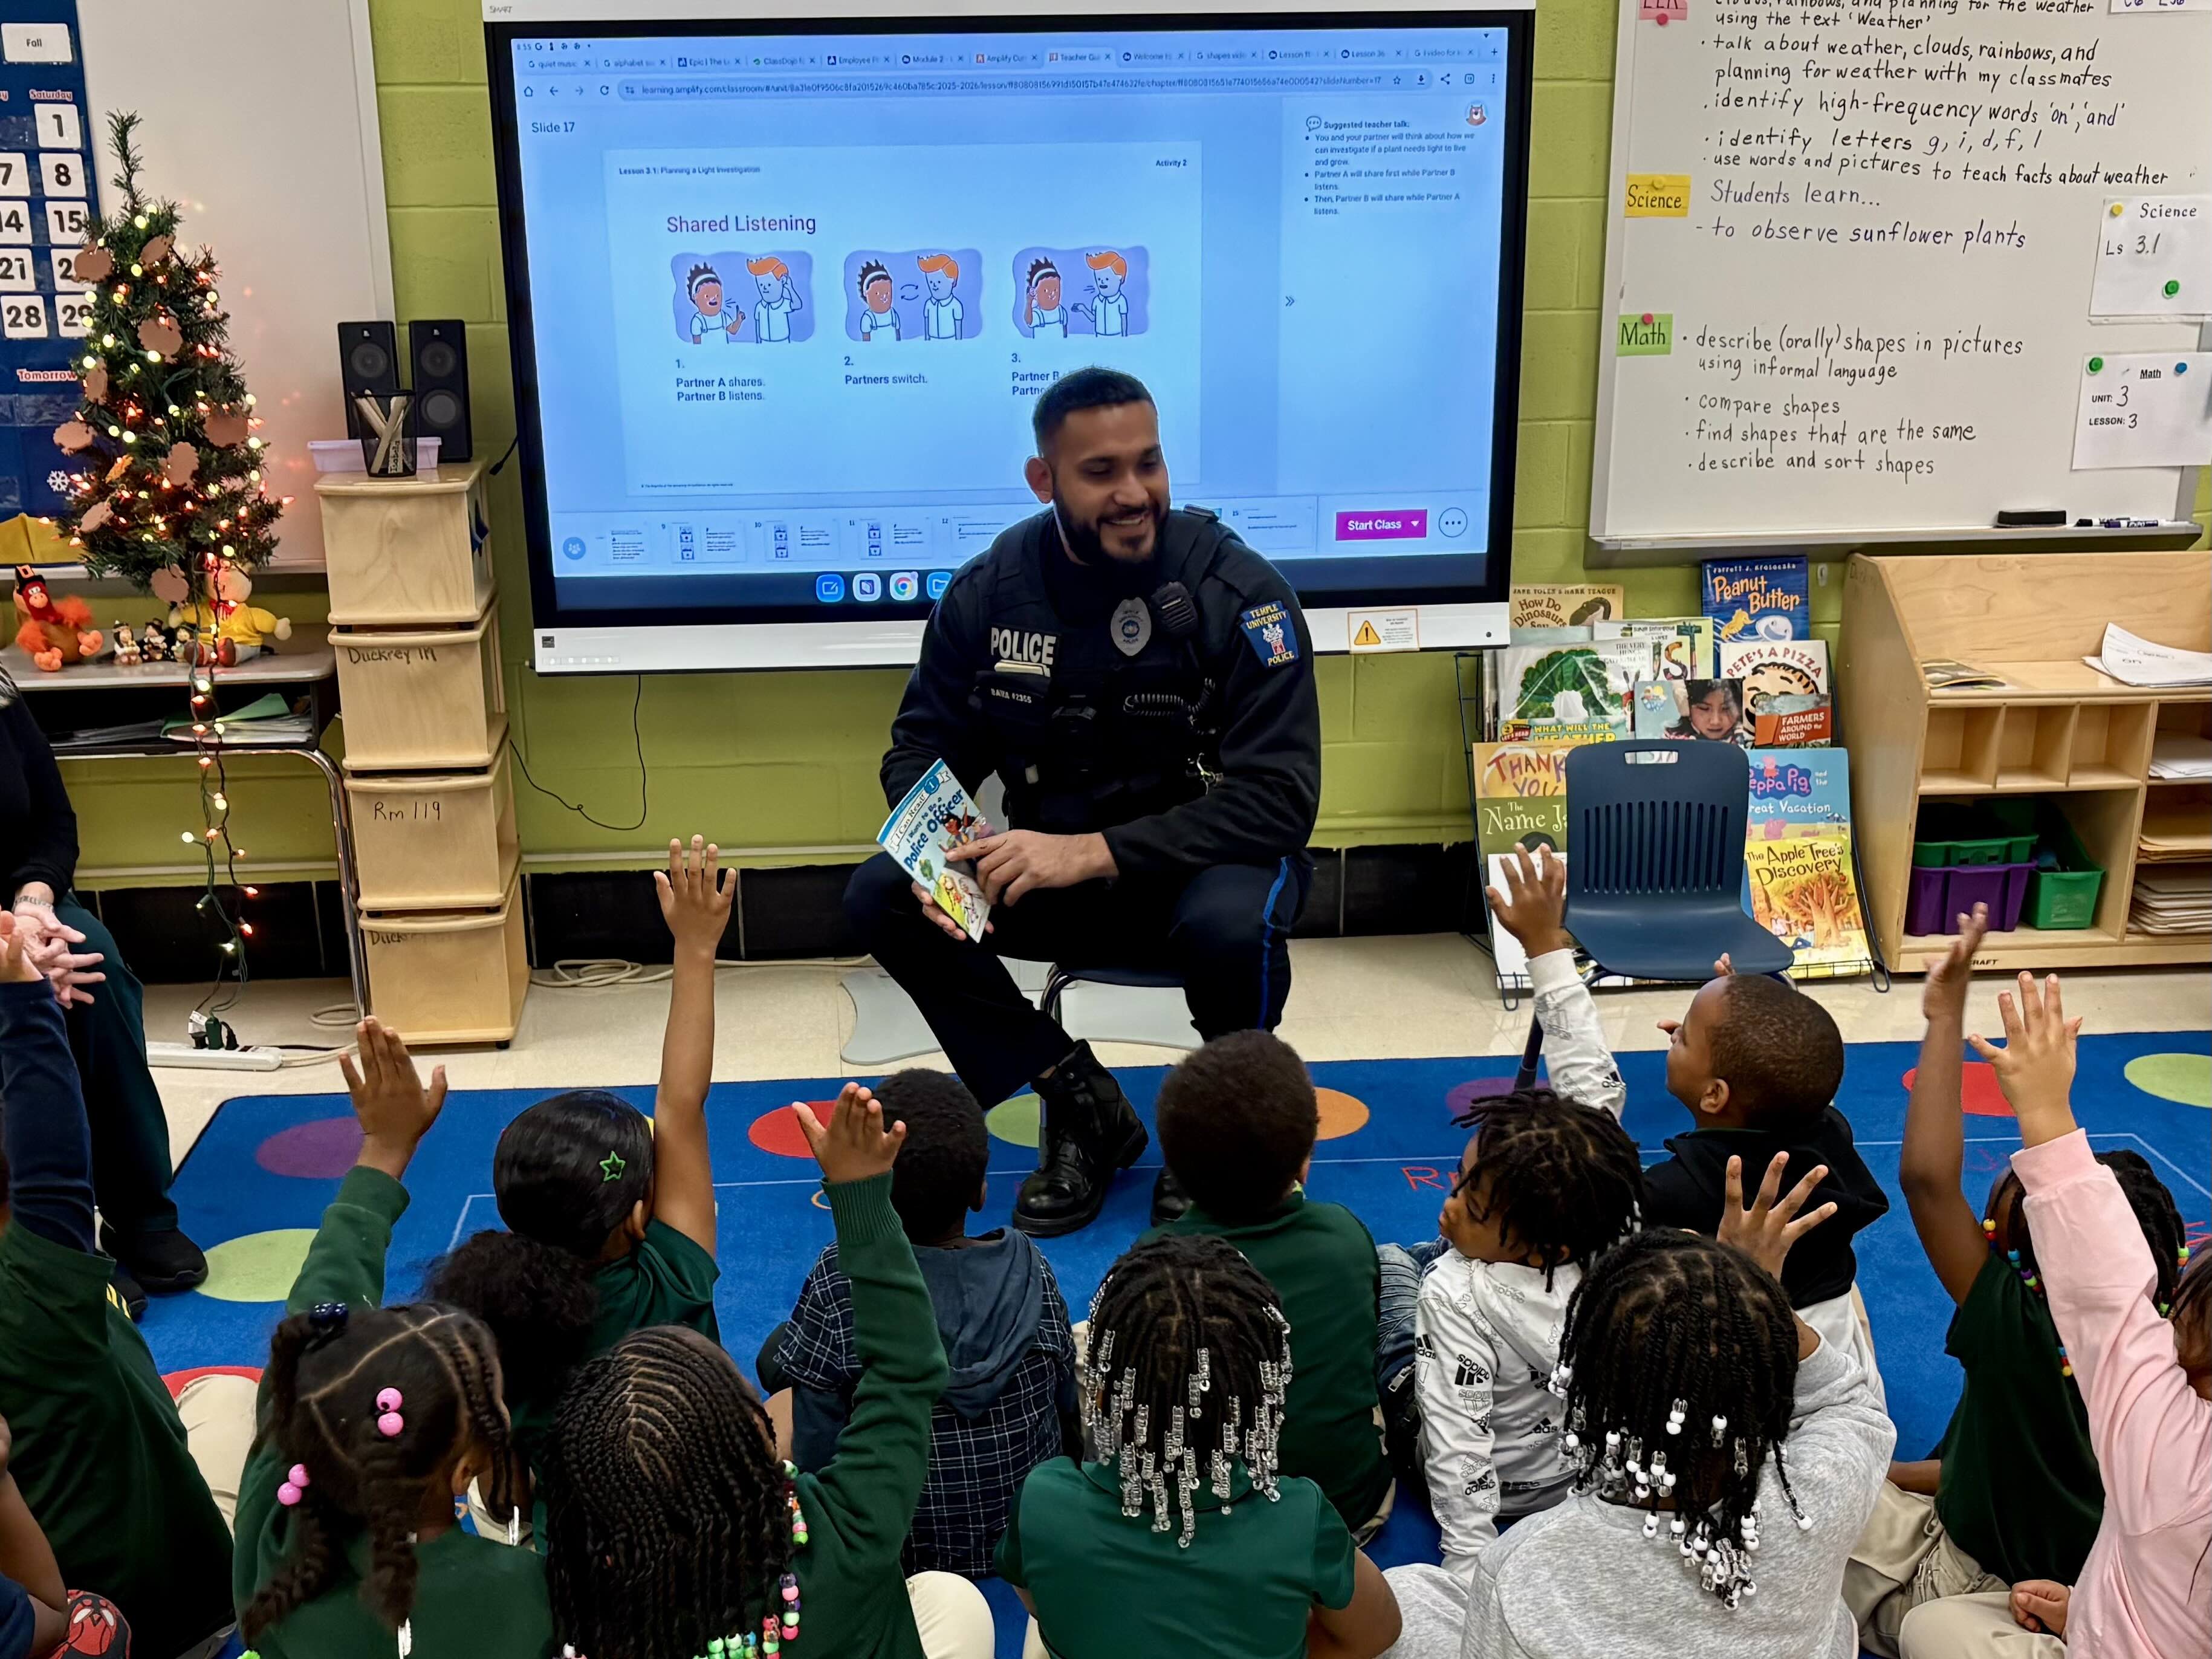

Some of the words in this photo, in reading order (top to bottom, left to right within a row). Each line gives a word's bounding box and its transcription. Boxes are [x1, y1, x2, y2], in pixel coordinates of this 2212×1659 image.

[1716, 13, 1757, 30] using
[1766, 11, 1791, 26] the
[1800, 10, 1841, 27] text
[26, 38, 42, 47] Fall
[1713, 33, 1752, 51] talk
[1764, 33, 1819, 53] about
[1828, 34, 1907, 60] weather,
[1913, 33, 1973, 62] clouds,
[1979, 41, 2056, 65] rainbows,
[2060, 37, 2100, 62] and
[1715, 57, 1791, 88] planning
[1802, 59, 1831, 79] for
[1836, 58, 1918, 79] weather
[1924, 60, 1967, 83] with
[1979, 71, 2001, 94] my
[2009, 63, 2112, 87] classmates
[30, 89, 73, 101] Saturday
[1715, 86, 1804, 117] identify
[1819, 88, 1983, 128] high-frequency
[1988, 99, 2038, 123] words
[52, 114, 64, 138] 1
[532, 122, 560, 132] Slide
[563, 122, 575, 132] 17
[1324, 122, 1363, 130] Suggested
[1363, 134, 1390, 142] partner
[661, 167, 690, 175] Planning
[1155, 159, 1181, 168] Activity
[1714, 154, 1740, 166] use
[1750, 149, 1797, 167] words
[1804, 152, 1833, 168] and
[1837, 151, 1921, 177] pictures
[1932, 161, 1951, 180] to
[1962, 161, 2006, 183] teach
[2014, 162, 2052, 184] facts
[2058, 161, 2101, 185] about
[2103, 163, 2168, 185] weather
[54, 163, 72, 187] 8
[1627, 181, 1682, 209] Science
[1710, 179, 1789, 204] Students
[2139, 203, 2197, 219] Science
[54, 210, 83, 233] 15
[667, 215, 728, 234] Shared
[735, 214, 816, 235] Listening
[1711, 216, 1734, 238] to
[1752, 218, 1838, 243] observe
[1849, 221, 1953, 245] sunflower
[1962, 218, 2026, 254] plants
[2135, 233, 2161, 255] 3.1
[0, 257, 26, 280] 21
[6, 305, 42, 328] 28
[1620, 323, 1665, 346] Math
[1696, 324, 1772, 352] describe
[1779, 323, 1841, 359] (orally)
[1843, 326, 1905, 365] shapes
[1916, 331, 1931, 351] in
[1943, 324, 2023, 360] pictures
[675, 359, 685, 369] 1.
[844, 356, 854, 366] 2.
[1011, 352, 1021, 363] 3.
[17, 369, 77, 382] Tomorrow
[845, 374, 889, 385] Partners
[892, 373, 928, 384] switch.
[1012, 371, 1050, 381] Partner
[1699, 358, 1741, 381] using
[1754, 355, 1820, 379] informal
[1828, 358, 1898, 387] language
[2140, 369, 2161, 379] Math
[676, 377, 716, 388] Partner
[718, 377, 726, 387] A
[728, 377, 766, 387] shares.
[677, 392, 716, 401] Partner
[719, 392, 726, 401] B
[728, 391, 765, 400] listens.
[2116, 385, 2129, 407] 3
[1699, 394, 1771, 418] compare
[1783, 393, 1840, 423] shapes
[2089, 417, 2125, 426] LESSON:
[2129, 414, 2138, 429] 3
[1696, 418, 1732, 442] find
[1740, 421, 1797, 454] shapes
[1808, 420, 1847, 446] that
[1858, 429, 1887, 446] are
[1896, 417, 1924, 441] the
[1932, 424, 1976, 441] same
[1698, 447, 1774, 471] describe
[1786, 450, 1815, 469] and
[1824, 449, 1865, 470] sort
[1875, 455, 1934, 484] shapes
[1348, 520, 1372, 531] Start
[1375, 519, 1402, 531] Class
[1712, 575, 1768, 603] Peanut
[1518, 599, 1544, 611] How
[1545, 597, 1562, 612] Do
[1748, 586, 1800, 615] Butter
[1246, 611, 1288, 629] UNIVERSITY
[1250, 604, 1279, 619] TEMPLE
[1513, 609, 1568, 628] Dinosaurs
[991, 627, 1057, 665] POLICE
[1267, 651, 1294, 667] POLICE
[1726, 648, 1763, 678] PETE'S
[1768, 647, 1778, 657] A
[1782, 648, 1822, 679] PIZZA
[1592, 722, 1610, 731] THE
[1780, 723, 1812, 734] AROUND
[1782, 712, 1825, 726] FARMERS
[1779, 732, 1806, 742] WORLD
[1487, 750, 1567, 783] THANK
[1513, 777, 1559, 797] YOU
[1788, 768, 1809, 791] Pig
[374, 801, 404, 821] Rm
[413, 801, 441, 821] 119
[1508, 802, 1523, 812] The
[1749, 803, 1774, 814] reat
[1779, 800, 1831, 814] Vacation
[904, 832, 929, 871] Police
[927, 789, 964, 834] Officer
[1483, 807, 1546, 835] Name
[1747, 851, 1764, 862] The
[1766, 845, 1805, 866] Apple
[1802, 842, 1844, 862] Tree's
[1457, 1353, 1491, 1381] adidas
